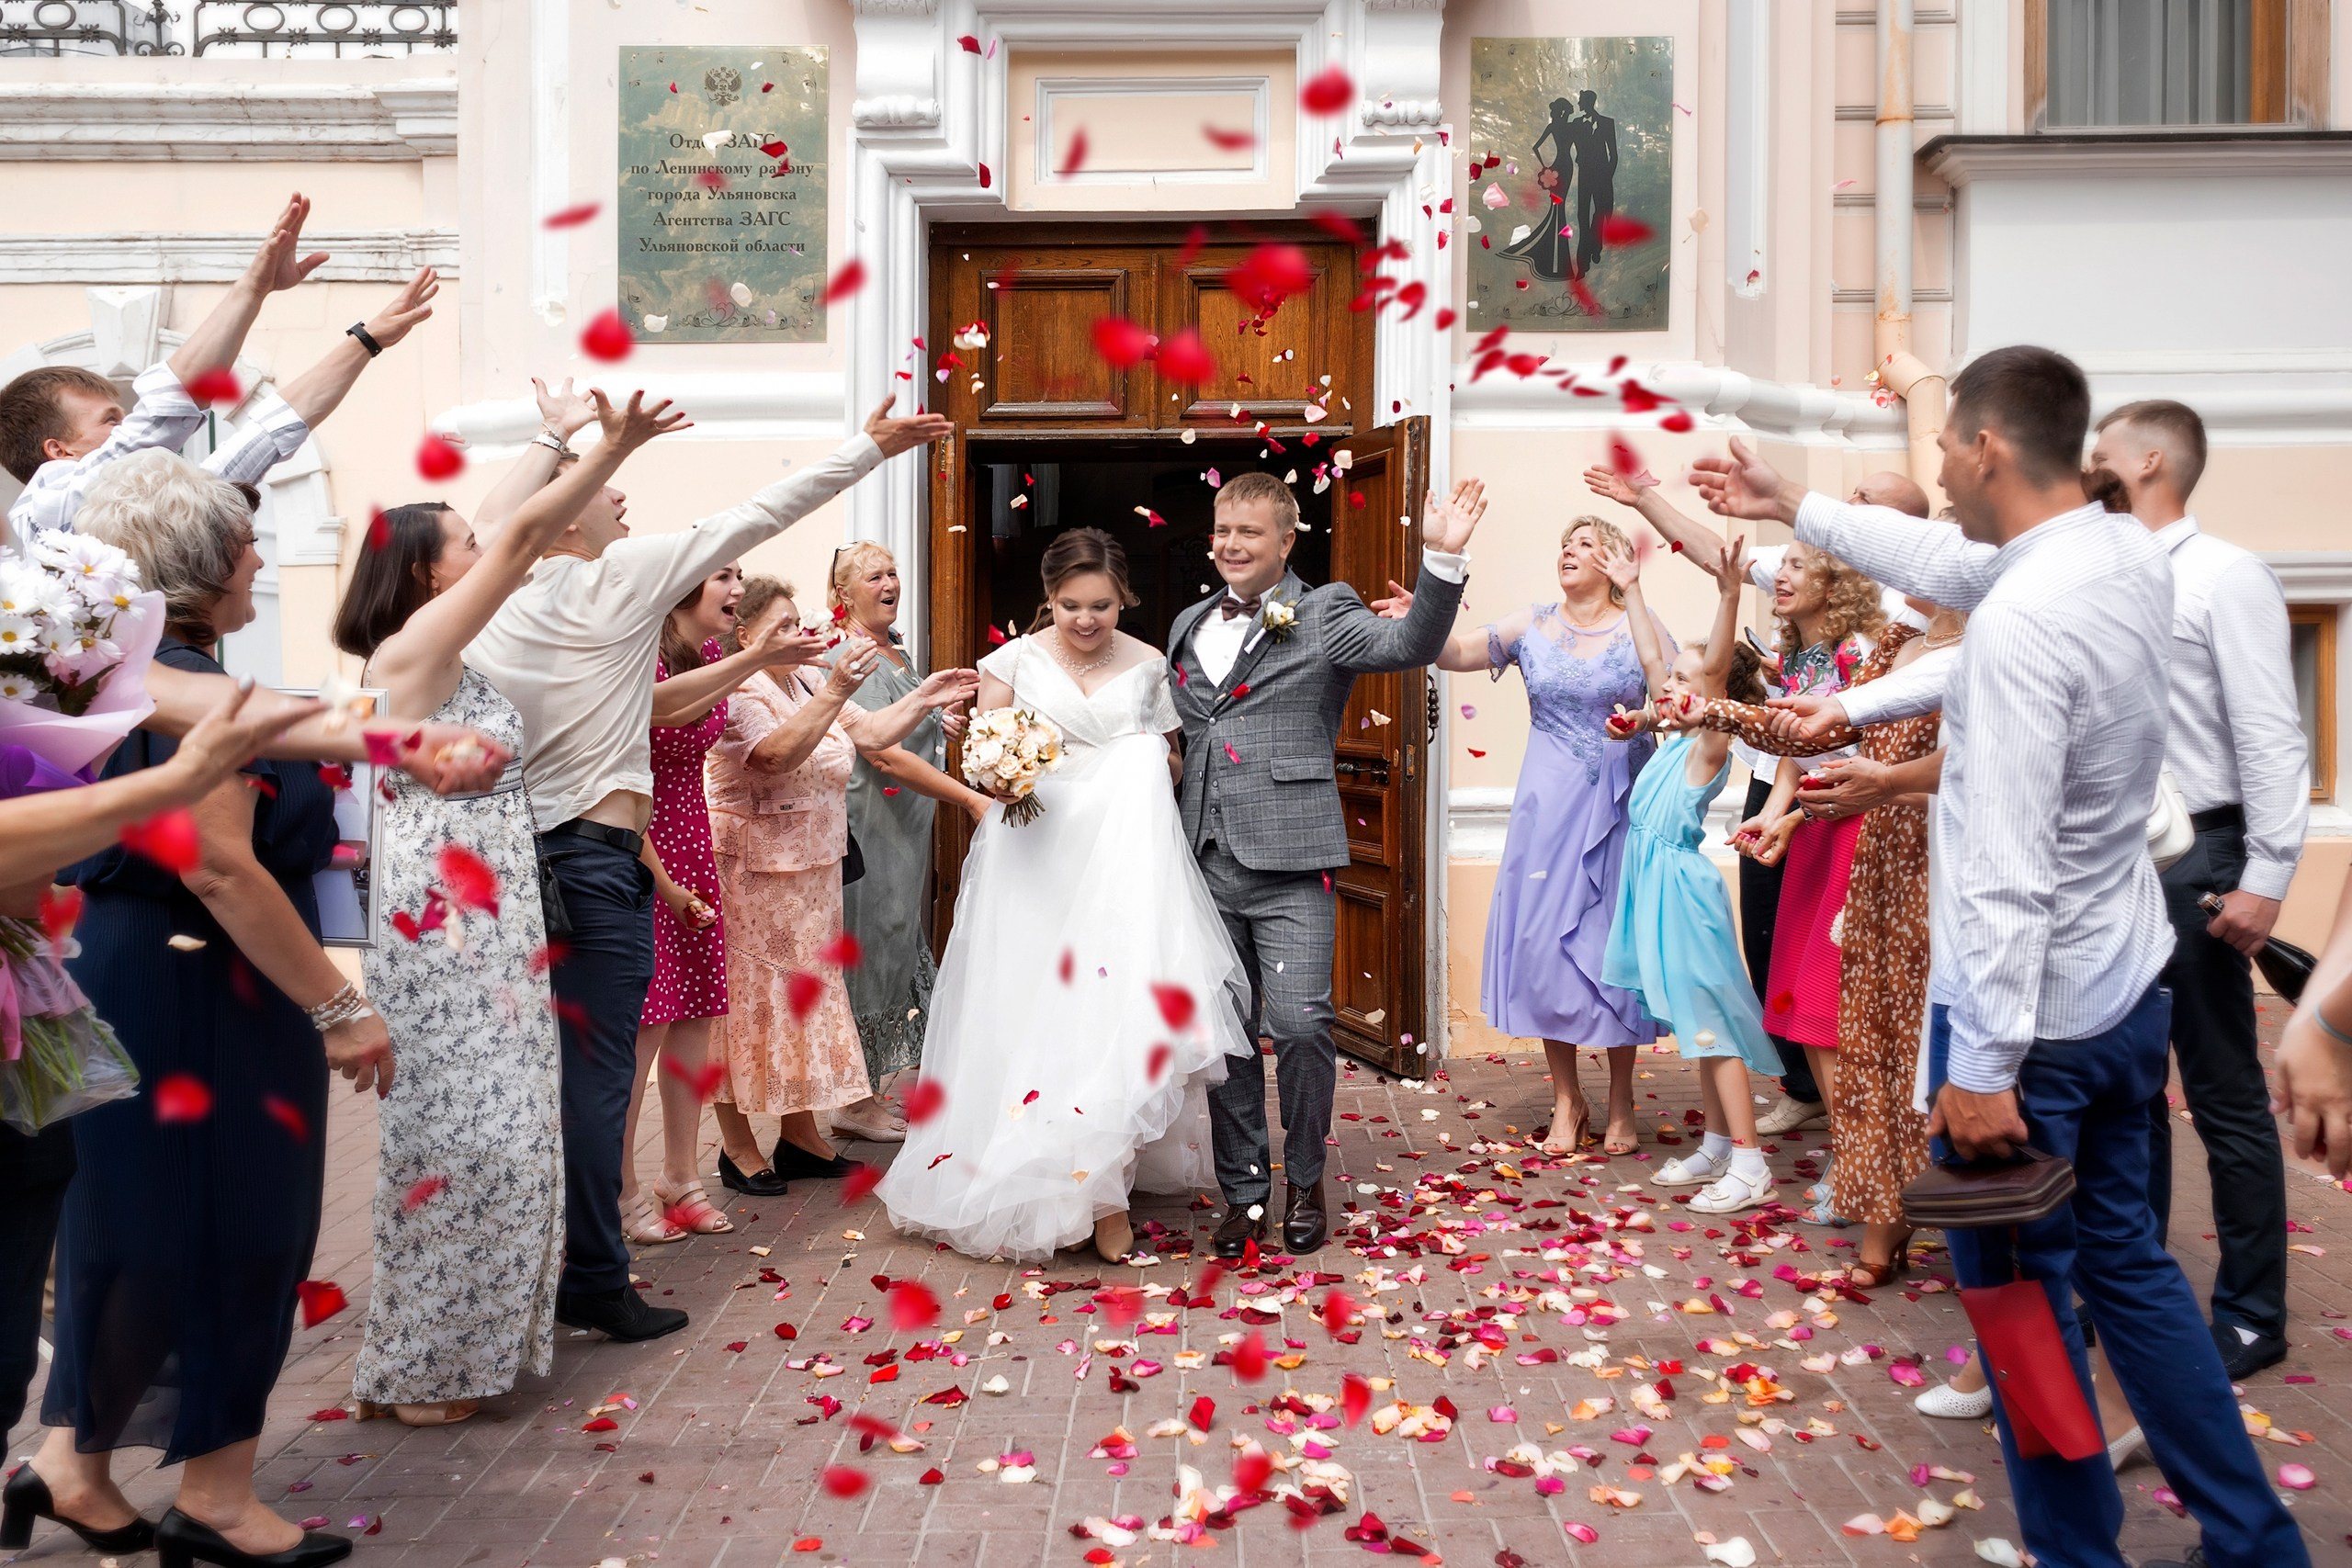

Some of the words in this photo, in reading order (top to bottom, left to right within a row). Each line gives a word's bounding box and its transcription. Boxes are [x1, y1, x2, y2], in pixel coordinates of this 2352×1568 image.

[669, 133, 718, 150] Отд
[630, 165, 650, 174] по
[655, 159, 752, 177] Ленинскому
[759, 160, 814, 177] раону
[648, 191, 700, 203] города
[707, 186, 797, 200] Ульяновска
[653, 211, 732, 226] Агентства
[739, 211, 791, 226] ЗАГС
[639, 237, 739, 252] Ульяновской
[745, 239, 805, 252] области
